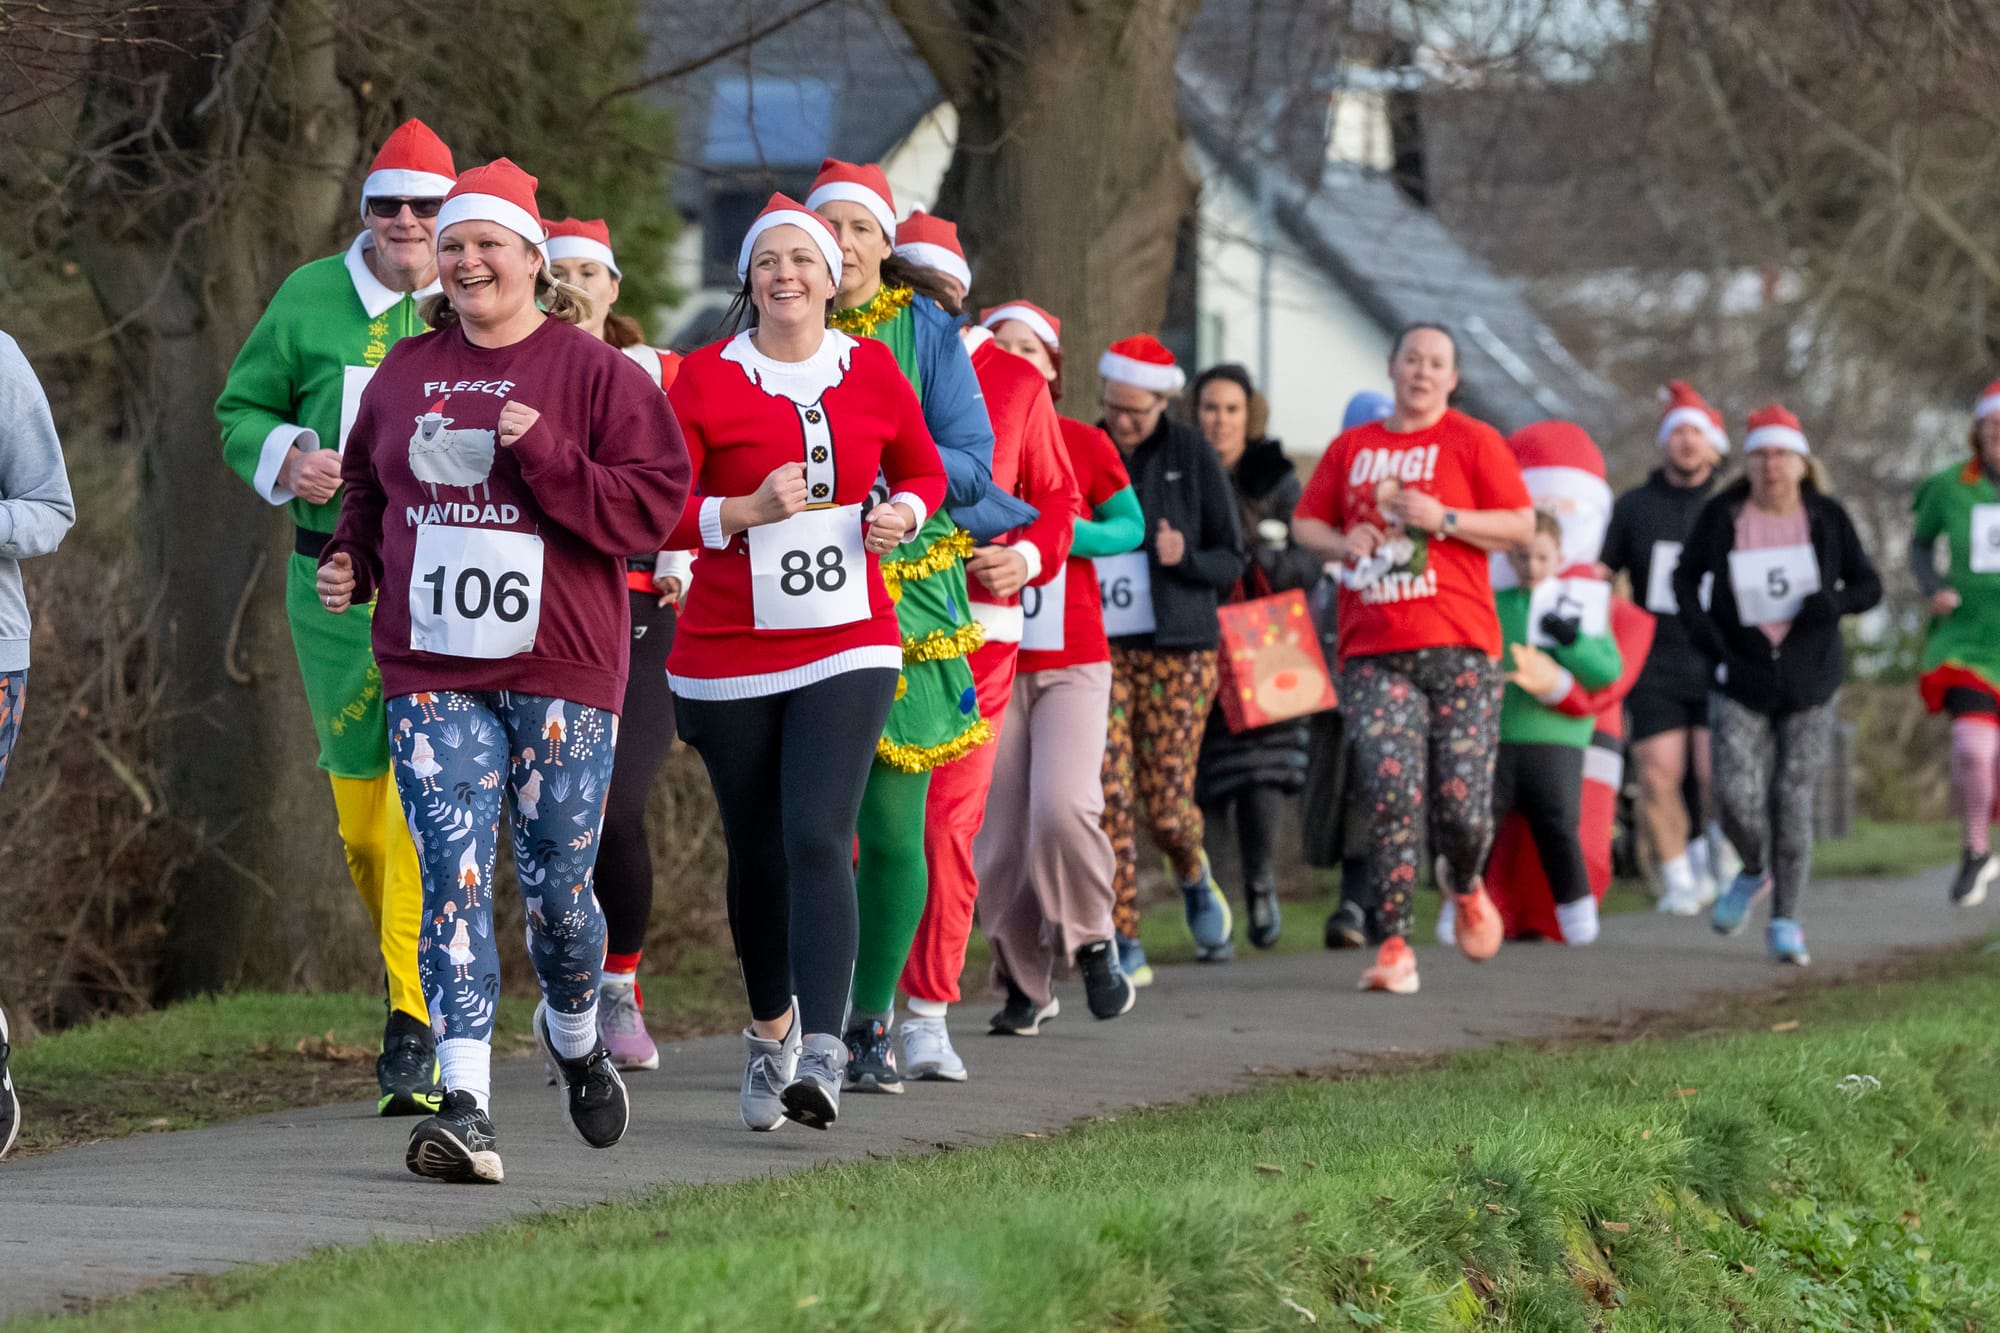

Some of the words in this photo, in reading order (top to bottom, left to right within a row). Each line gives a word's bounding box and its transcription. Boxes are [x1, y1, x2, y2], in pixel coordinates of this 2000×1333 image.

[424, 380, 515, 398] FLEECE
[1348, 444, 1439, 487] OMG!
[406, 502, 520, 526] NAVIDAD
[780, 545, 847, 596] 88
[1767, 568, 1789, 597] 5
[423, 566, 530, 622] 106
